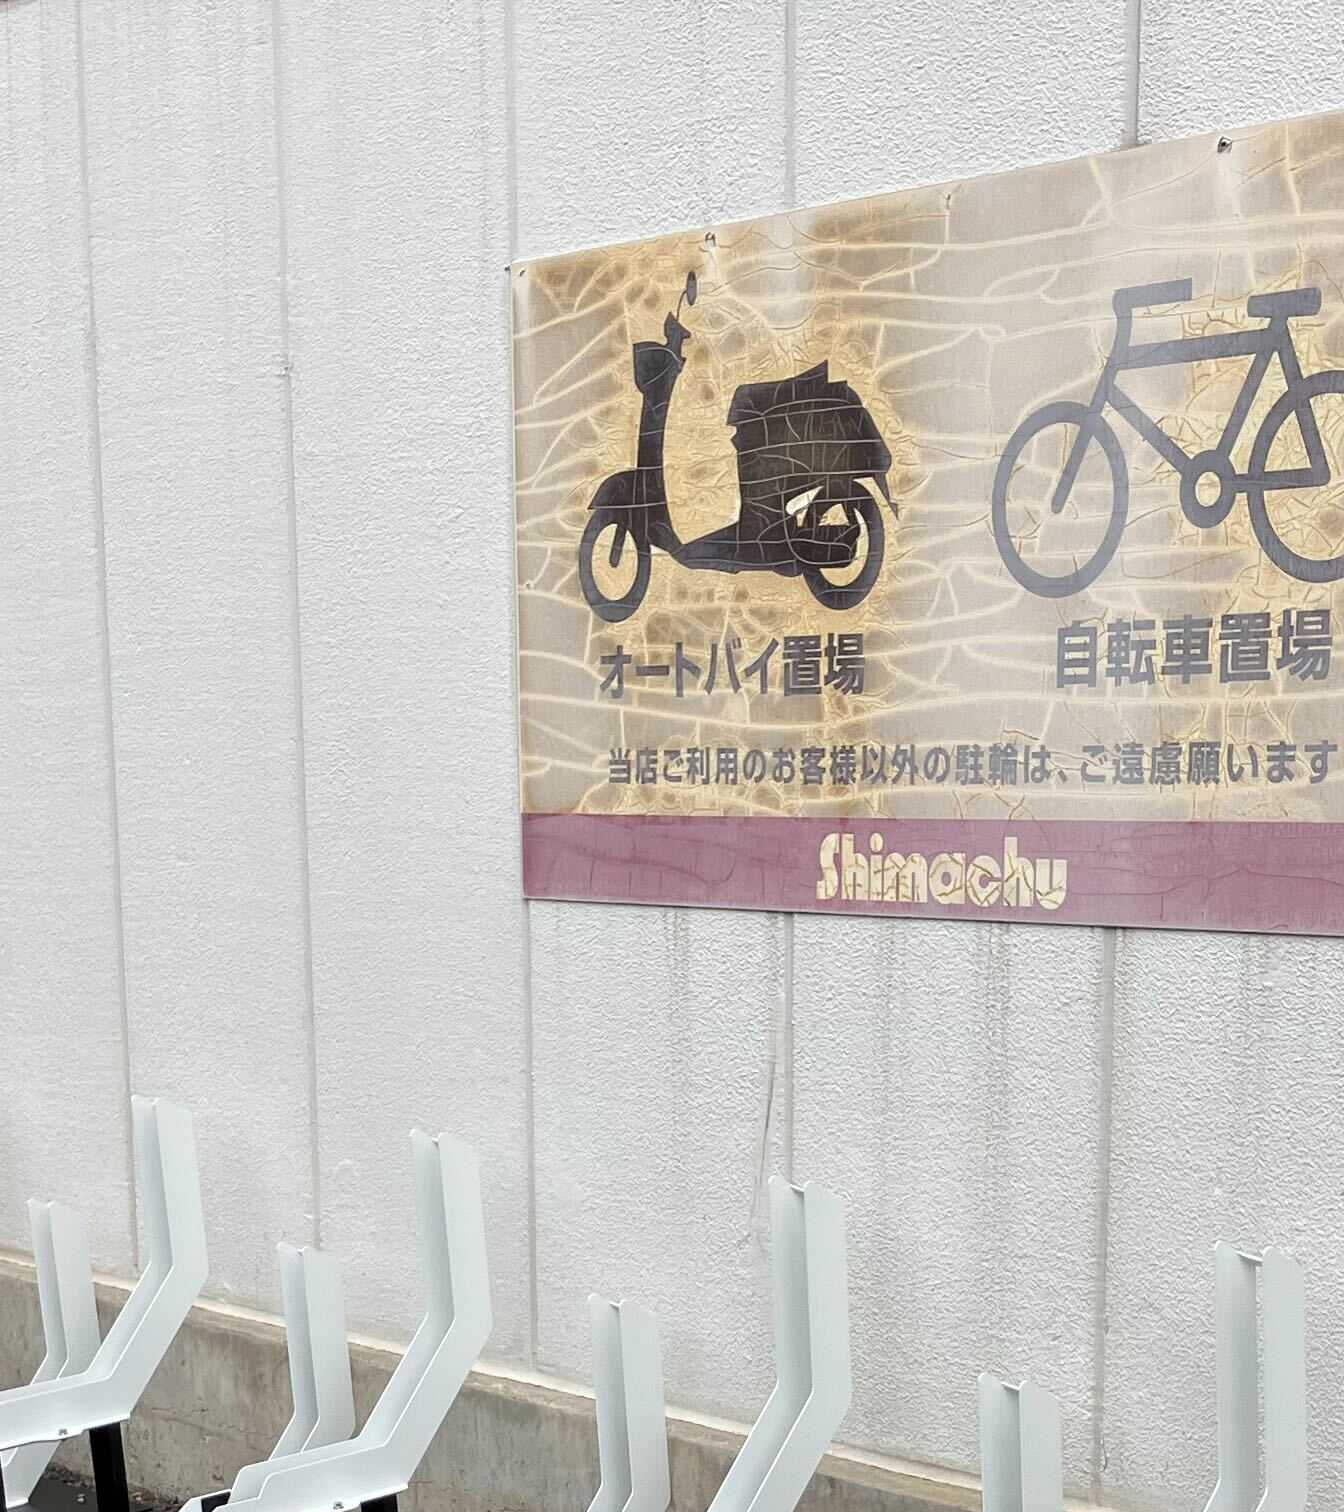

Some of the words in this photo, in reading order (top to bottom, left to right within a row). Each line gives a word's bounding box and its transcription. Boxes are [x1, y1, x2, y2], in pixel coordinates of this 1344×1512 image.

[599, 632, 865, 699] オートバイ置場
[1055, 608, 1333, 688] 自転車置場
[815, 832, 1069, 911] Shimachu
